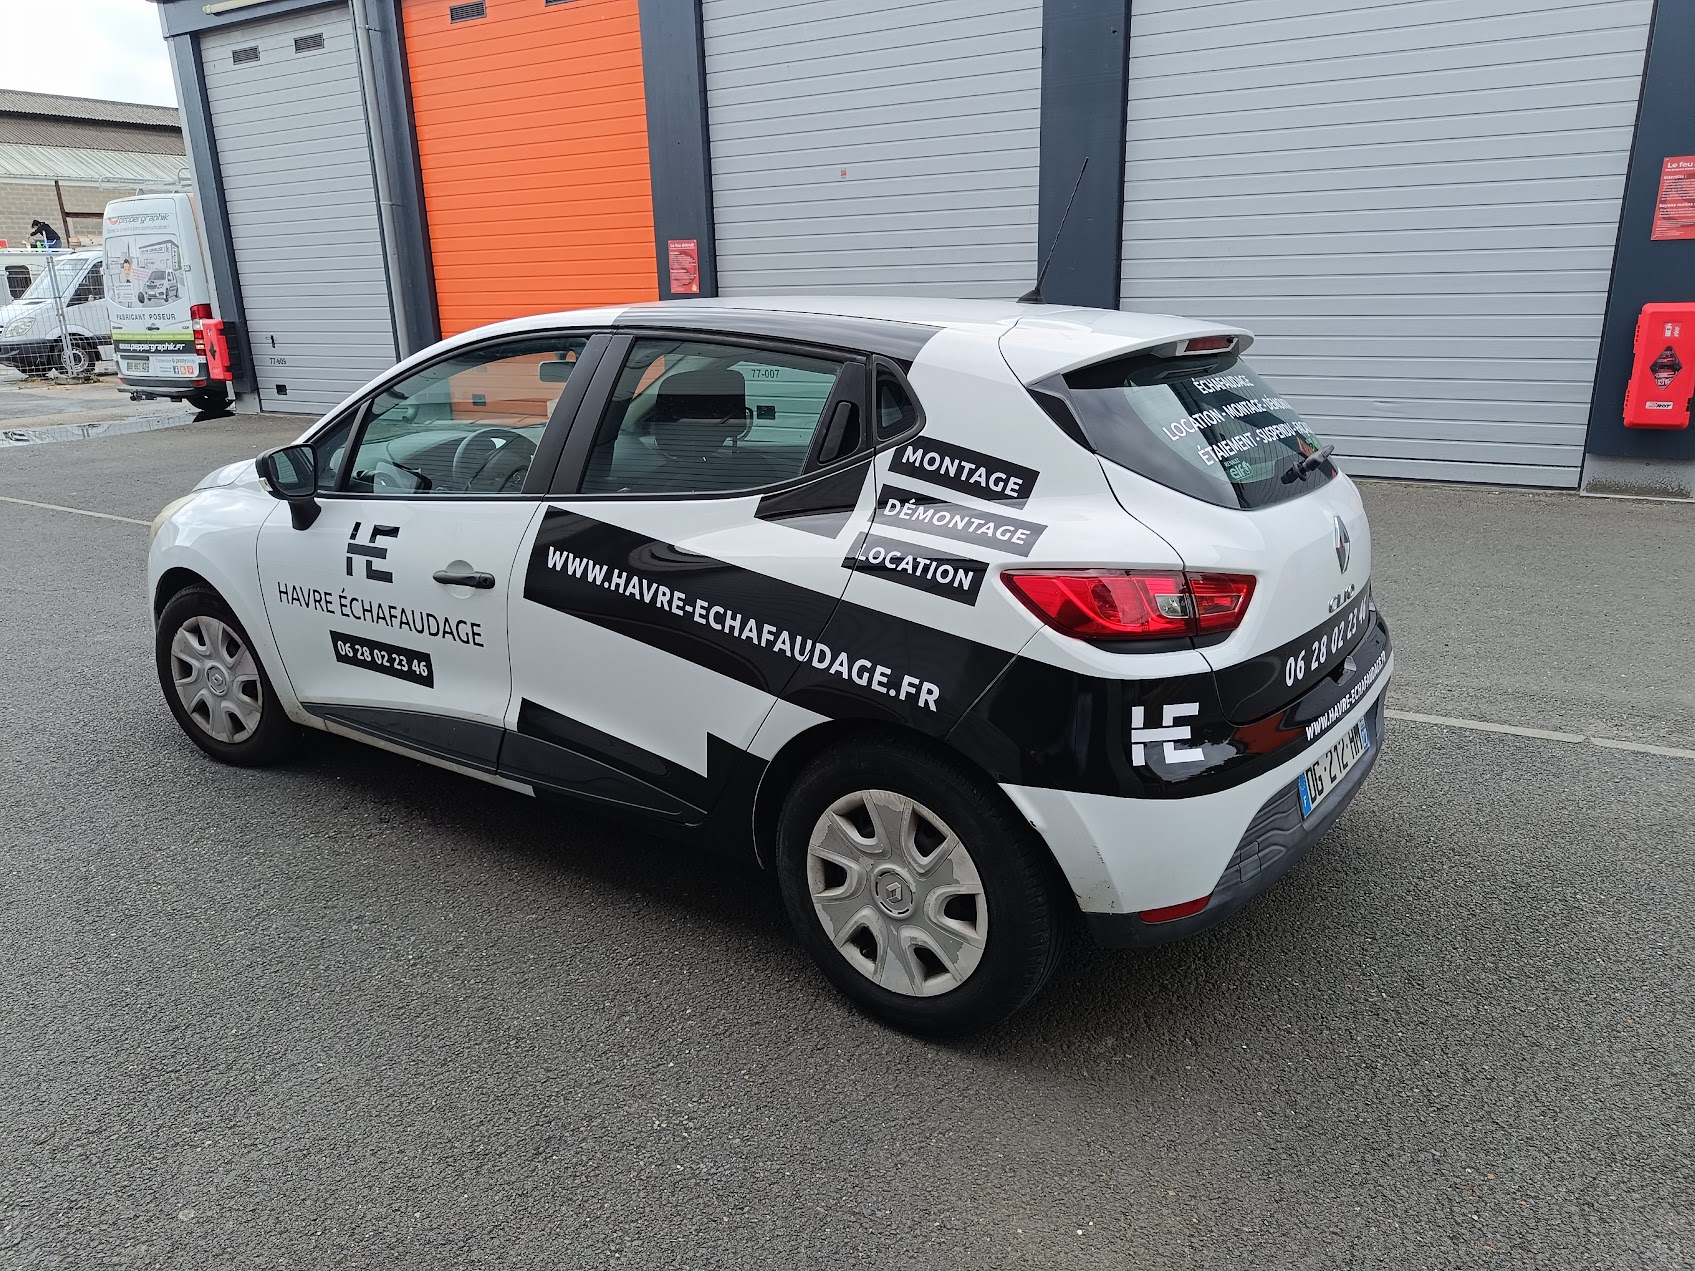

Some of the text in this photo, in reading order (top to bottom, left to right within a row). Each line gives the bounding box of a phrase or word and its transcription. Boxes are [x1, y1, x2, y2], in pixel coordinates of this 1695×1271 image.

[148, 313, 176, 321] POSEUR
[751, 369, 780, 379] 77-007
[1192, 375, 1255, 395] ÉCHAFAUDAGE
[1162, 408, 1225, 441] LOCATION
[1222, 398, 1266, 419] MONTAGE
[1197, 433, 1258, 466] ÉTAIEMENT
[1256, 422, 1296, 444] SUSPENDU
[901, 445, 1024, 498] MONTAGE
[883, 498, 1031, 545] DÉMONTAGE
[855, 543, 975, 591] LOCATION
[277, 581, 485, 648] HAVRE ÉCHAFAUDAGE
[547, 545, 941, 712] WWW.HAVRE-ECHAFAUDAGE.FR
[337, 640, 429, 677] 06 28 02 23 46
[1285, 649, 1306, 687] 06
[1311, 634, 1328, 671] 28
[1331, 620, 1345, 654] 02
[1346, 607, 1358, 640] 23
